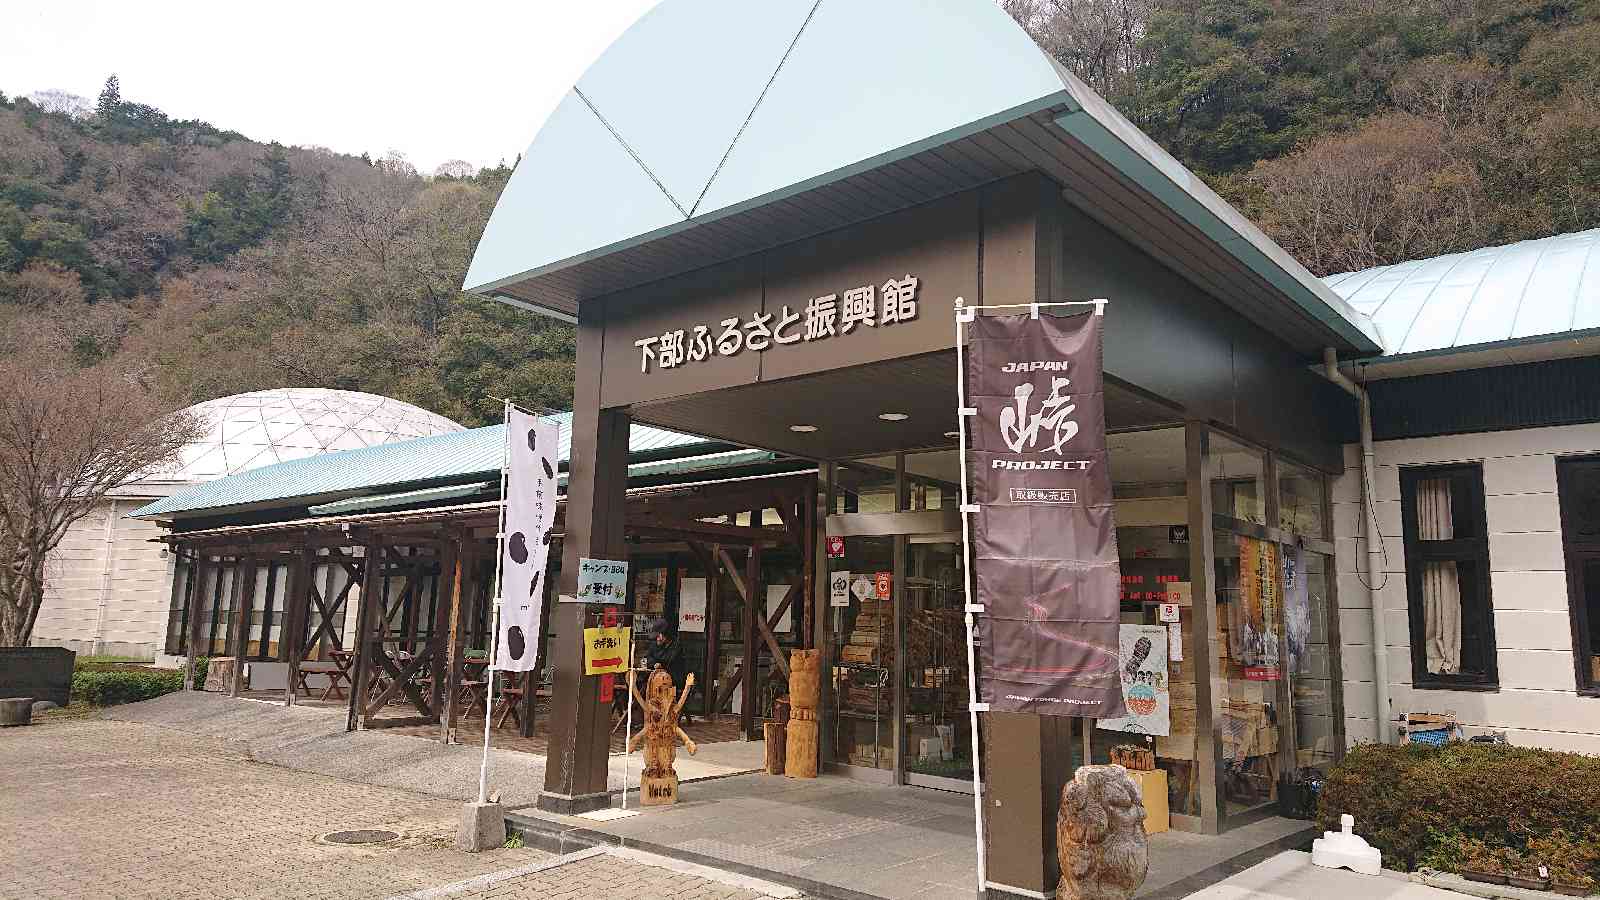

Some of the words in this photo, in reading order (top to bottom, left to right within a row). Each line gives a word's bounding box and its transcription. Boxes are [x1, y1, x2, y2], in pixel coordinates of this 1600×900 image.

[634, 273, 919, 374] 下部ふるさと振興館
[1001, 361, 1068, 373] JAPAN
[991, 459, 1090, 470] PROJECT
[592, 582, 613, 595] 受付
[593, 637, 621, 649] お手洗い
